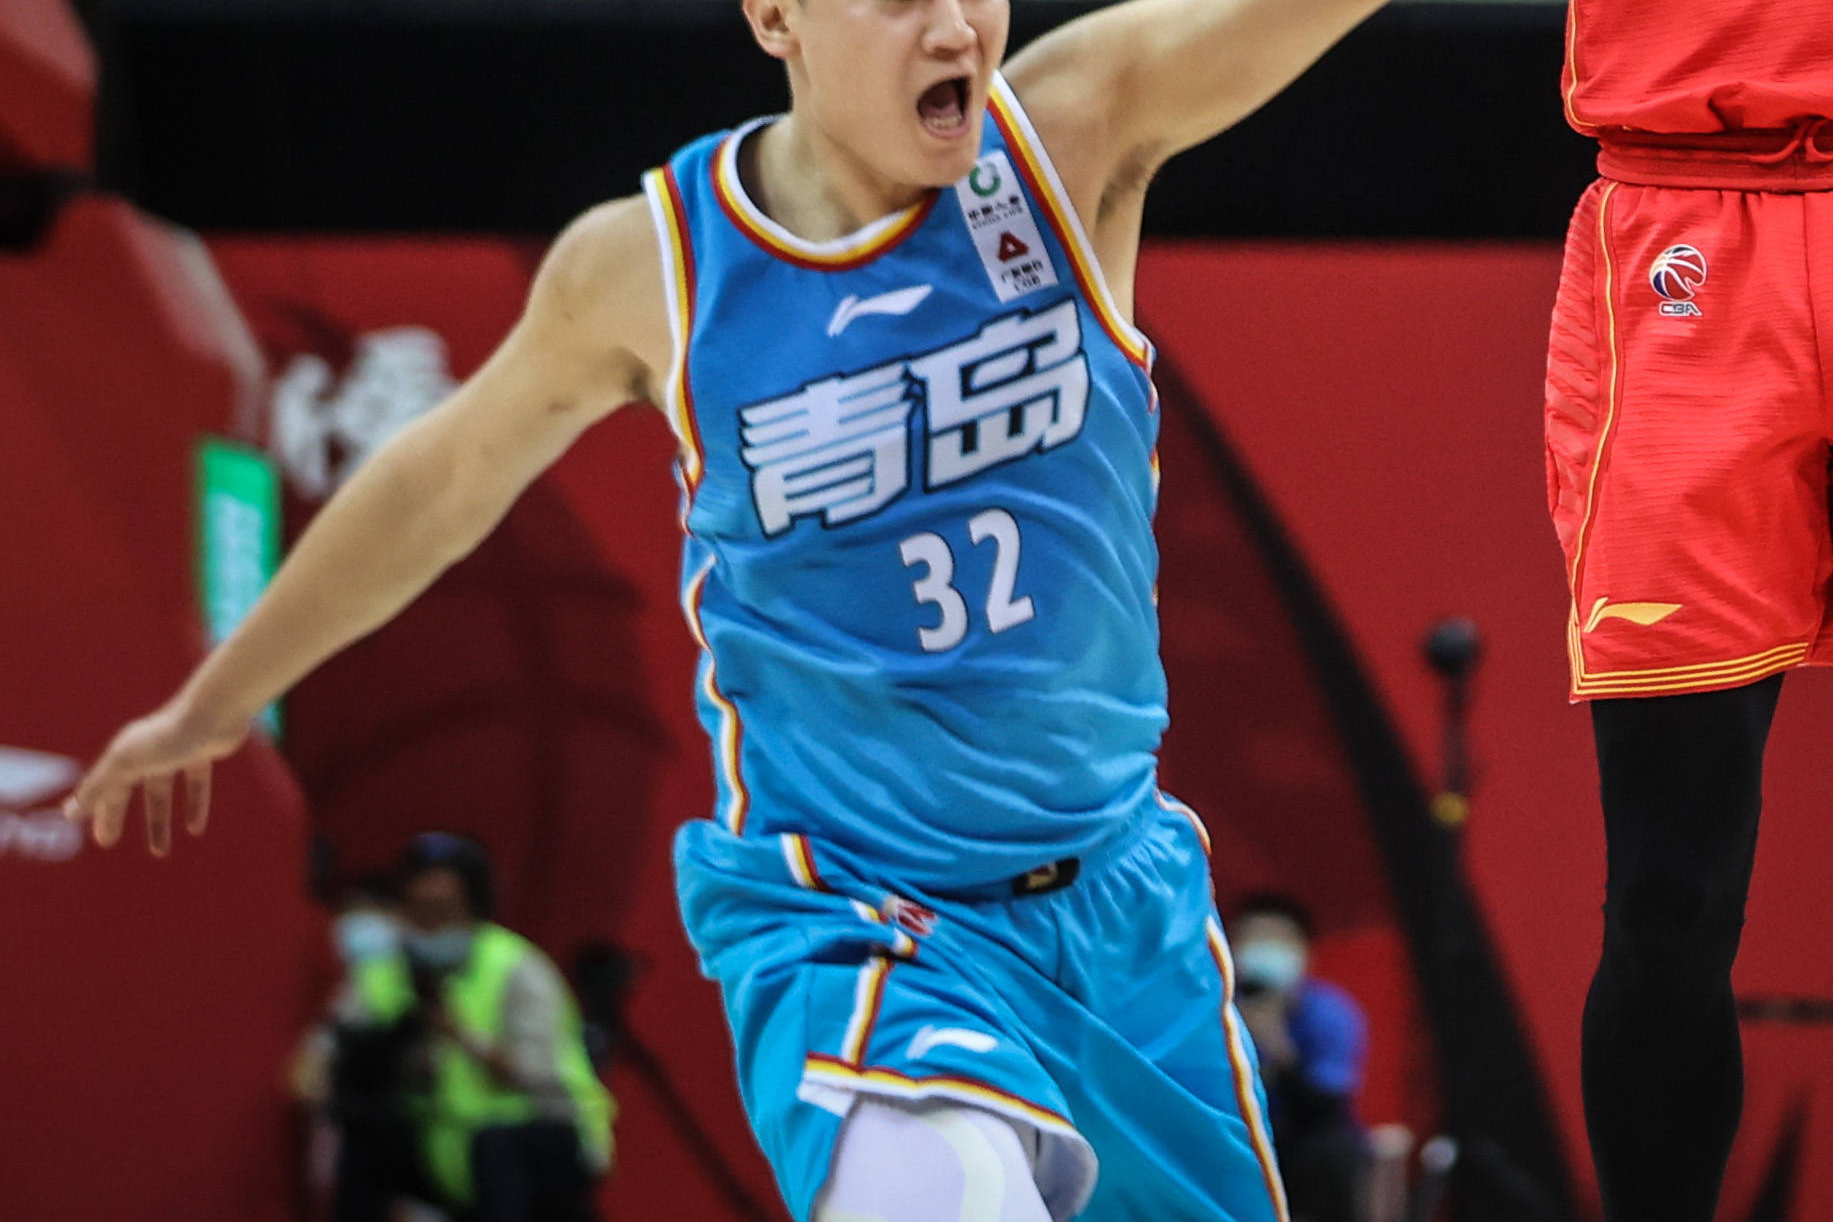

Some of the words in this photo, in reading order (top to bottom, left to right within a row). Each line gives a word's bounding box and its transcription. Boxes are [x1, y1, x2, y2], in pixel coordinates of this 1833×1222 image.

[1659, 301, 1703, 316] CBA
[737, 298, 1090, 540] 青岛
[898, 508, 1037, 653] 32
